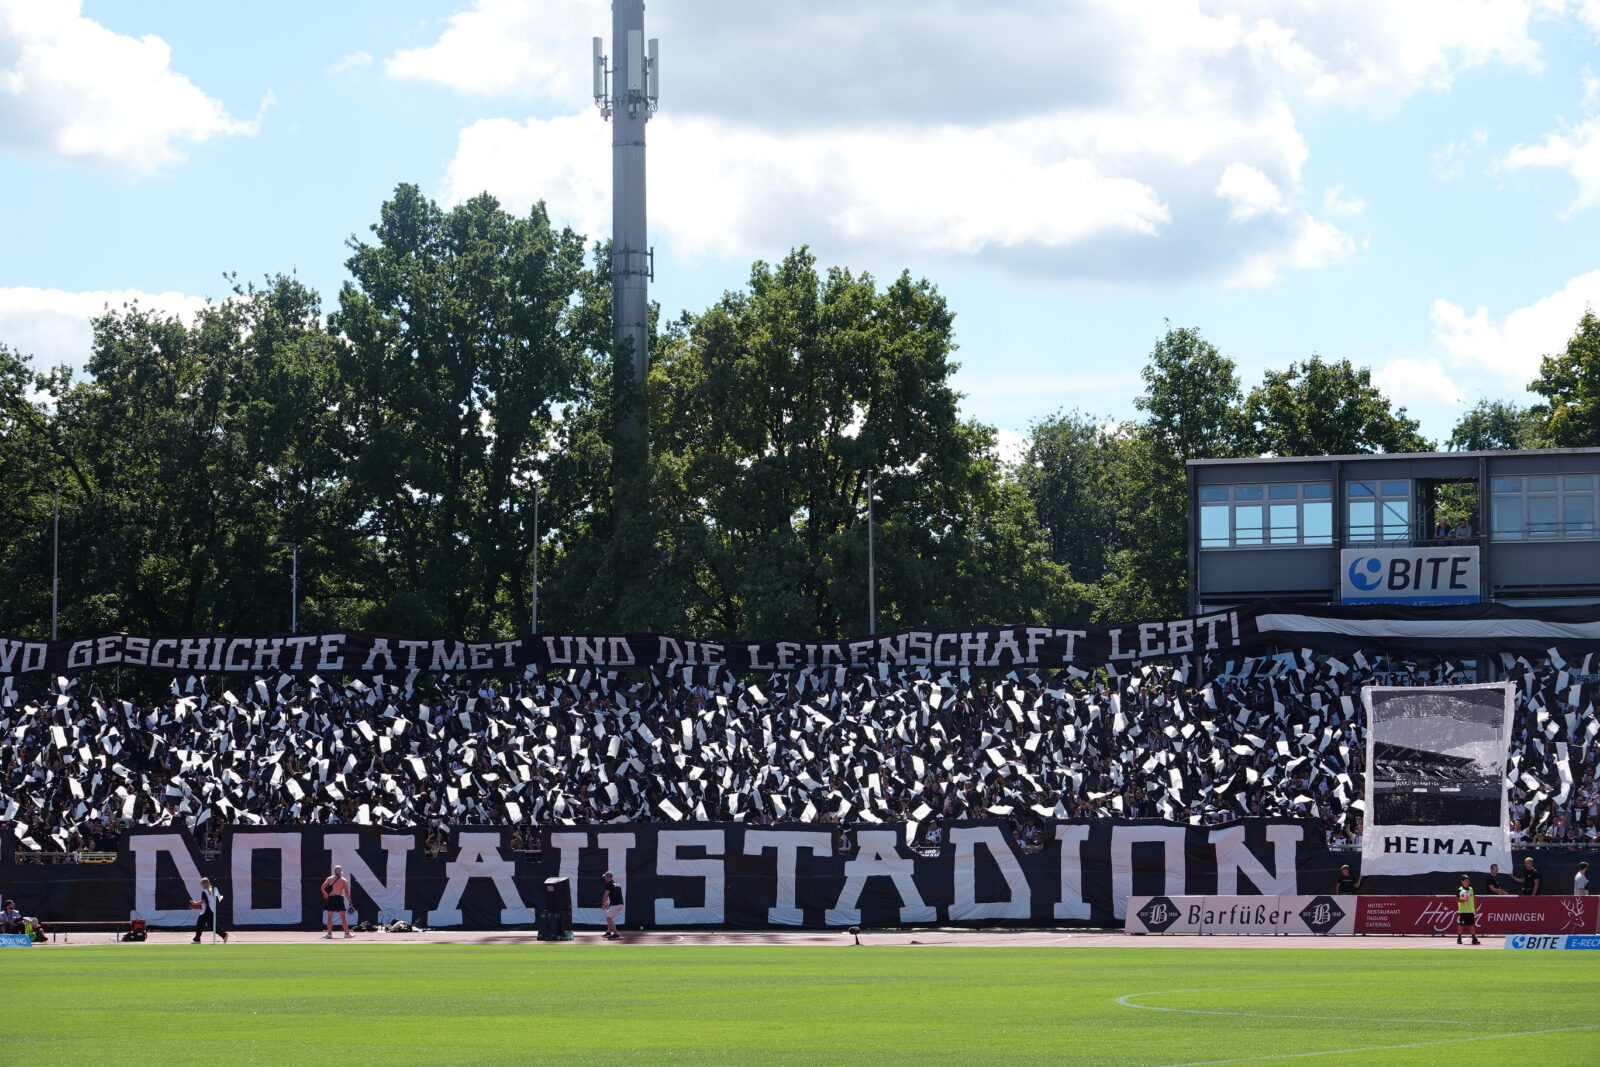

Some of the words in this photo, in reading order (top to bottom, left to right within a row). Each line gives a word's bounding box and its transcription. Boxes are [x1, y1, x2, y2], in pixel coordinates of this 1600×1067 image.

[1387, 557, 1472, 591] BITE
[67, 634, 347, 671] GESCHICHTE
[361, 638, 522, 670] ATMET
[542, 636, 636, 666] UND
[657, 636, 726, 665] DIE
[747, 627, 1087, 670] LEIDENSCHAFT
[1108, 611, 1241, 660] LEBT!
[1383, 836, 1493, 857] HEIMAT
[129, 824, 1304, 927] DONAUSTADION
[1187, 904, 1293, 925] Barfüßer
[1487, 912, 1545, 922] FINNINGEN
[1526, 936, 1560, 949] BITE
